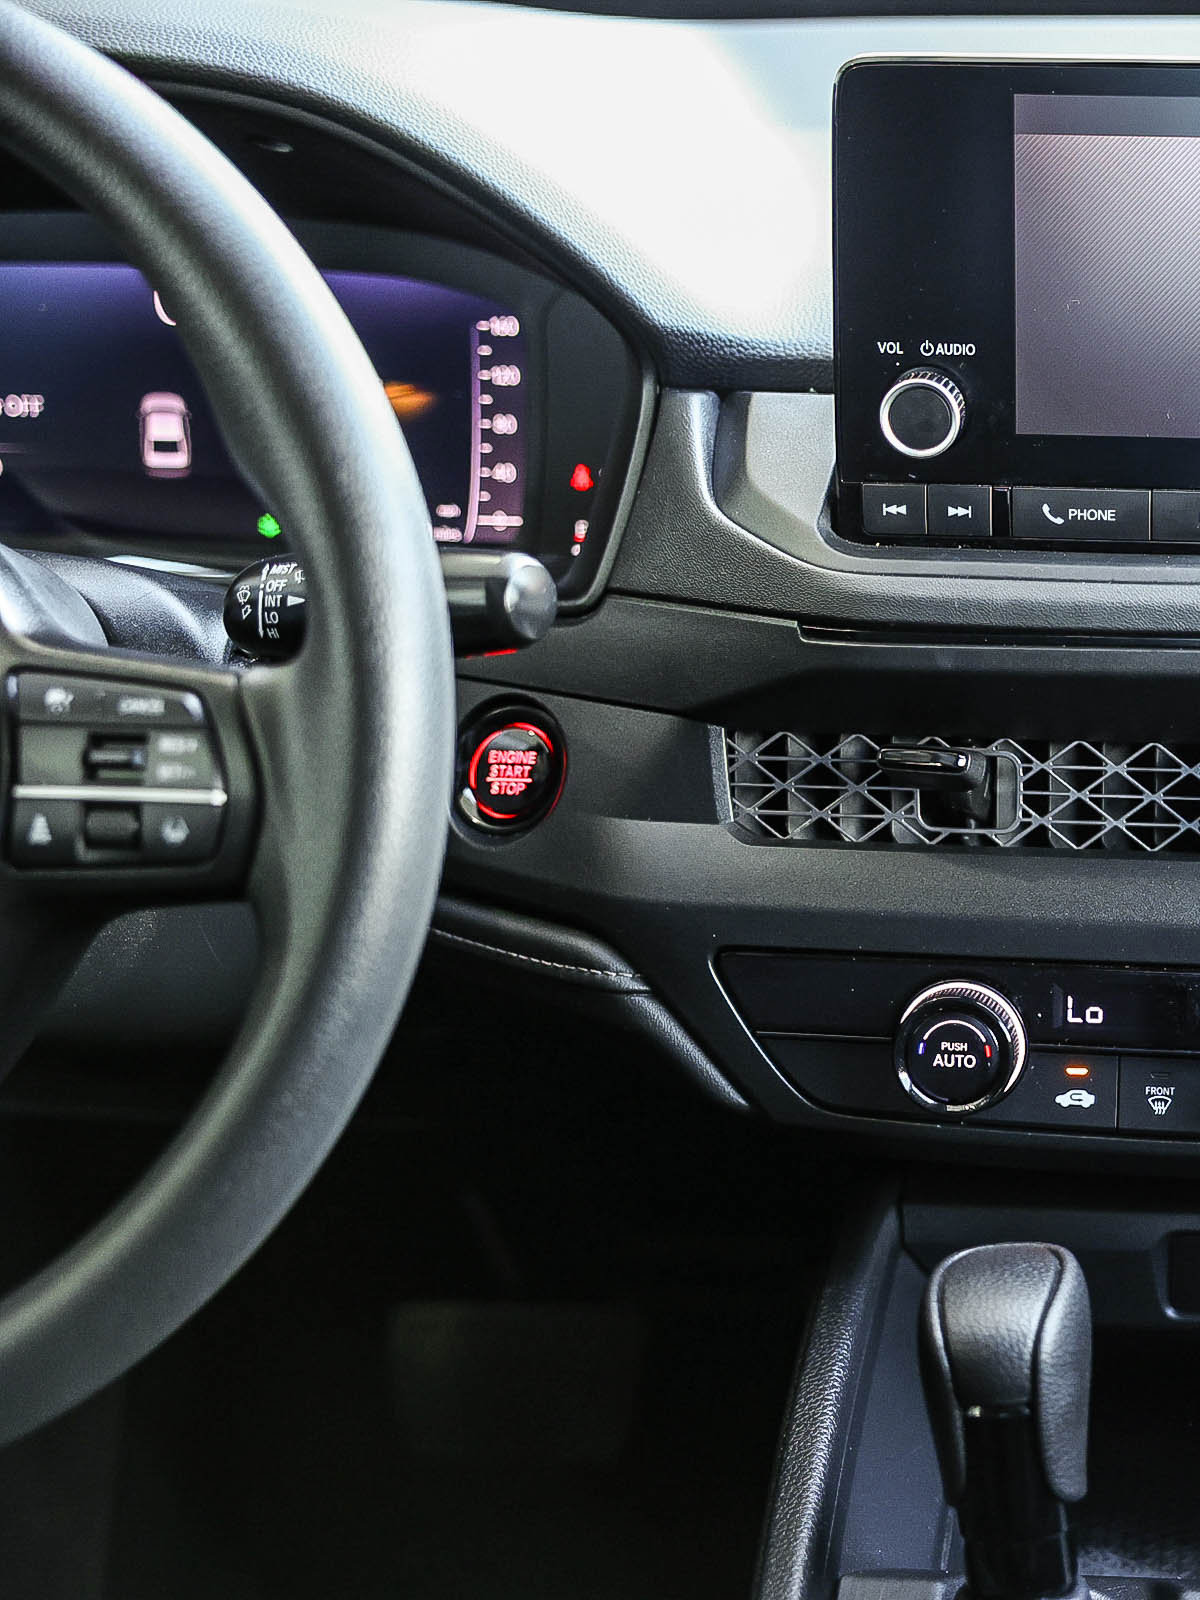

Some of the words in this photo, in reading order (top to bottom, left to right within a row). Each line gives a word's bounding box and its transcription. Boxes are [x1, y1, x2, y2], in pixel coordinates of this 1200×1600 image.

[876, 341, 904, 355] VOL
[935, 342, 976, 356] AUDIO
[1068, 508, 1117, 522] PHONE
[268, 562, 299, 577] MIST
[265, 576, 289, 593] OFF
[264, 594, 283, 607] INT
[264, 611, 279, 624] LO
[266, 627, 280, 639] HI
[487, 749, 538, 765] ENGINE
[488, 764, 533, 778] START
[489, 781, 529, 796] STOP
[1066, 995, 1104, 1024] Lo
[940, 1041, 968, 1052] PUSH
[932, 1053, 977, 1069] AUTO
[1144, 1086, 1176, 1097] FRONT
